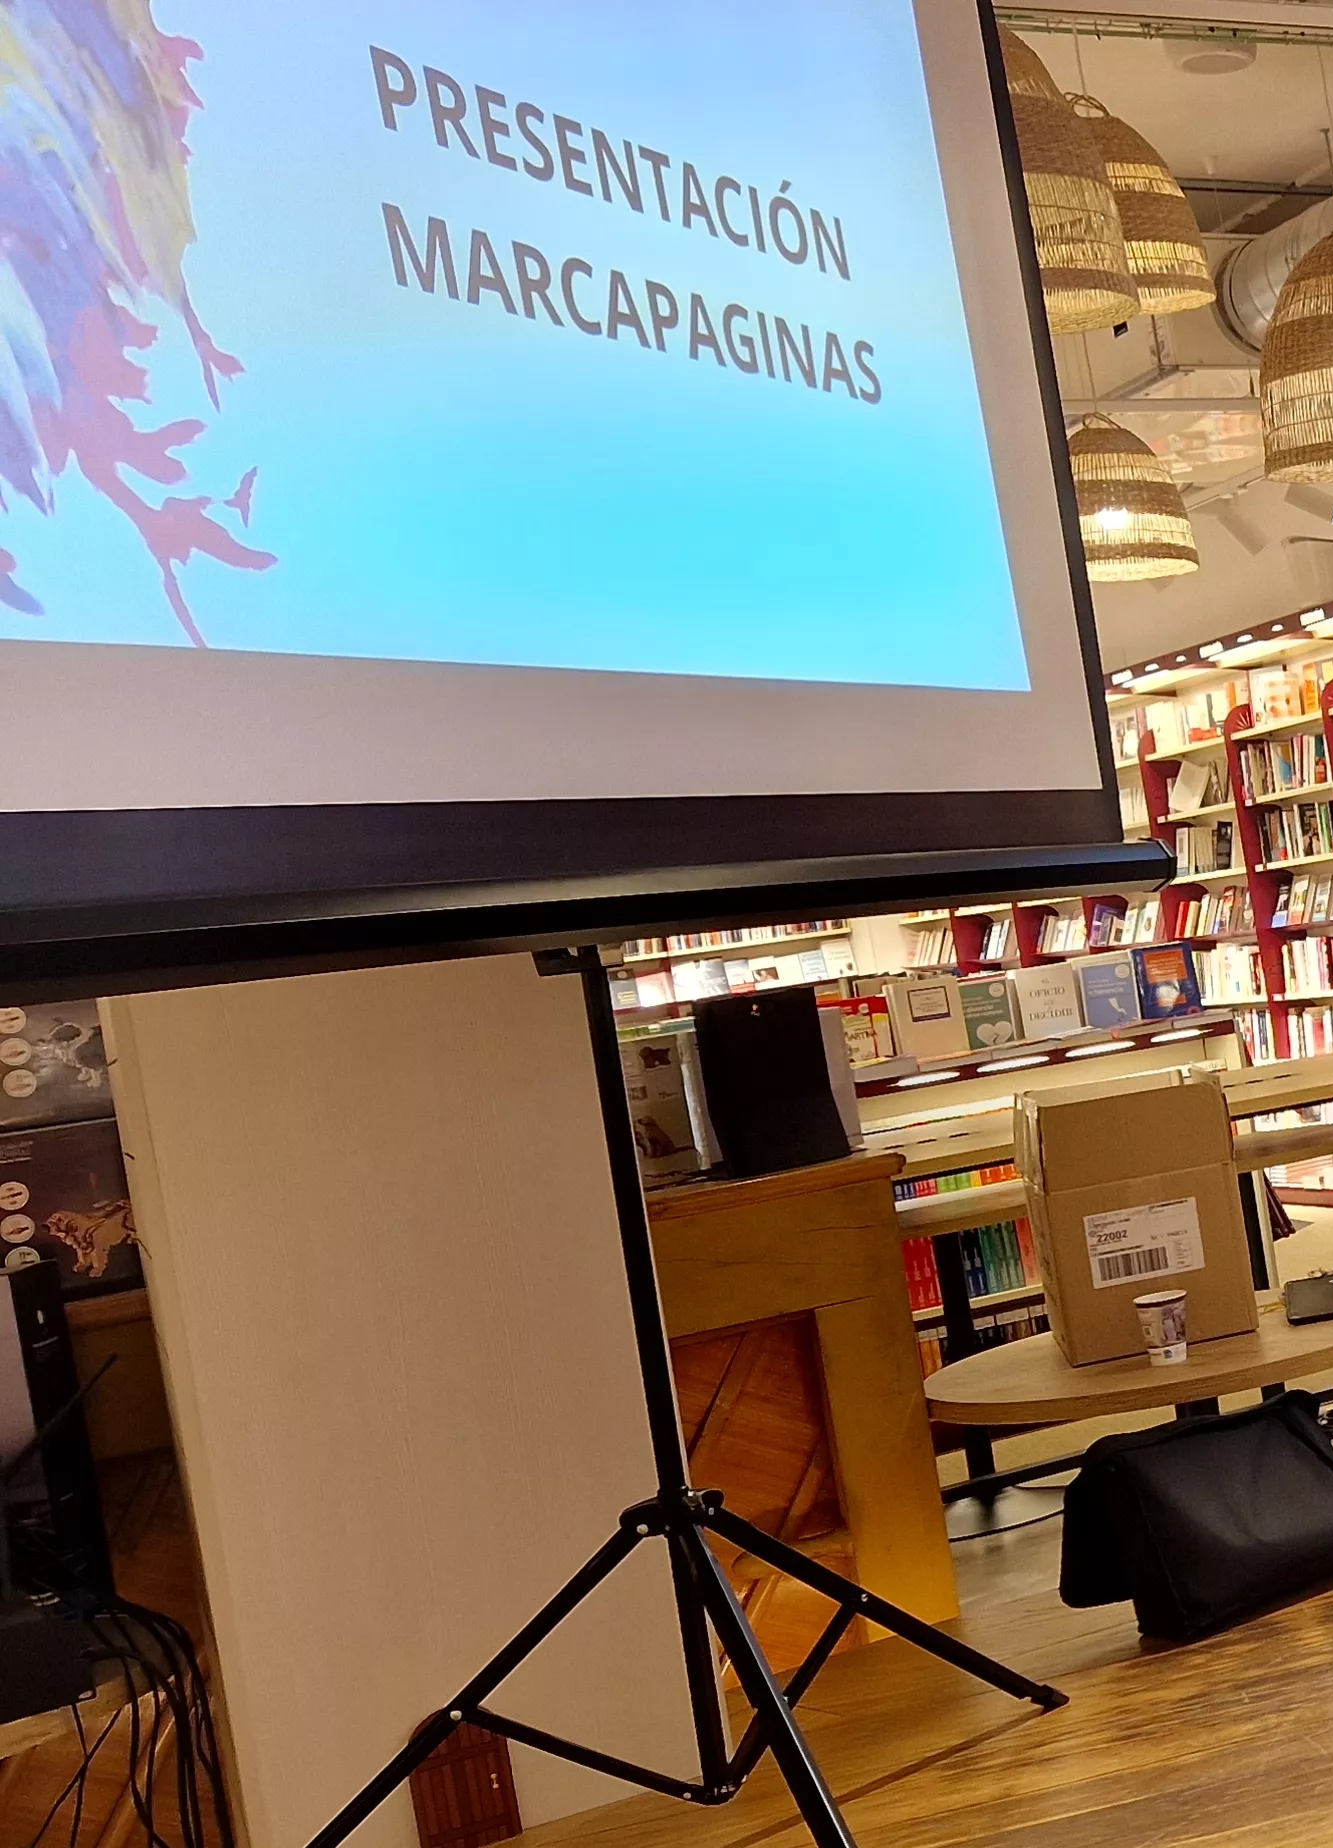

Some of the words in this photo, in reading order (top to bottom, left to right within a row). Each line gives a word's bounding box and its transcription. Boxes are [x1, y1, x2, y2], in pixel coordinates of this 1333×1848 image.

[369, 44, 852, 282] PRESENTACIÓN
[380, 202, 883, 404] MARCAPAGINAS
[1029, 987, 1066, 999] OFICIO
[1028, 1007, 1074, 1022] DECIDIR
[1096, 1229, 1129, 1243] 22002
